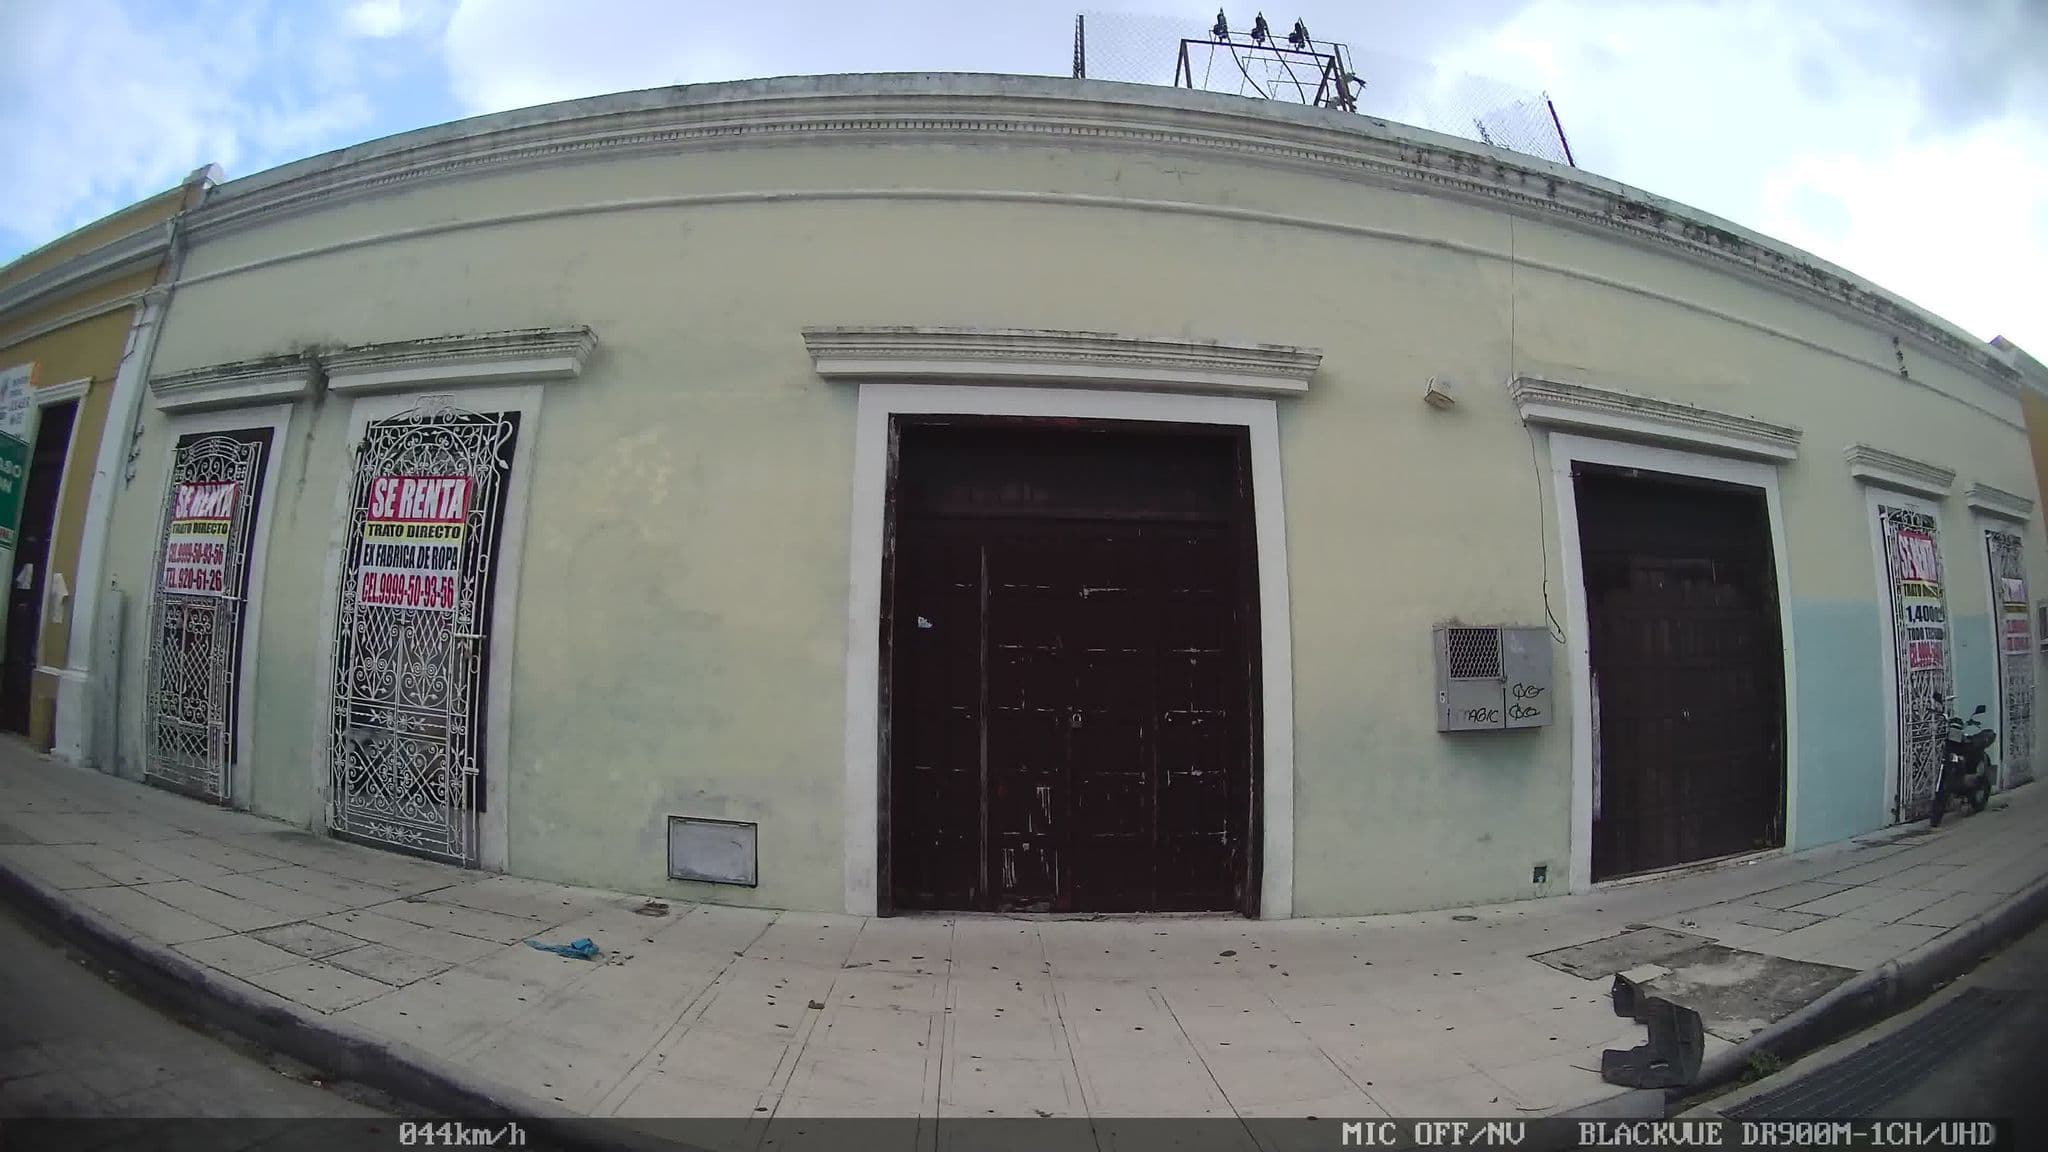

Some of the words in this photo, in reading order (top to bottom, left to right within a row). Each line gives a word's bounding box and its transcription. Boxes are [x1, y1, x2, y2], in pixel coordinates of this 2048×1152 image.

[175, 484, 196, 518] SE
[189, 483, 236, 518] RENTA
[372, 478, 399, 518] SE
[399, 478, 466, 519] RENTA
[172, 522, 193, 534] TRATO
[193, 522, 229, 534] DIRECTO
[367, 523, 404, 538] TRATO
[406, 525, 461, 539] DIRECTO
[363, 543, 376, 566] EX
[375, 544, 416, 568] FABRICA
[416, 546, 430, 569] DE
[431, 546, 458, 570] ROPA
